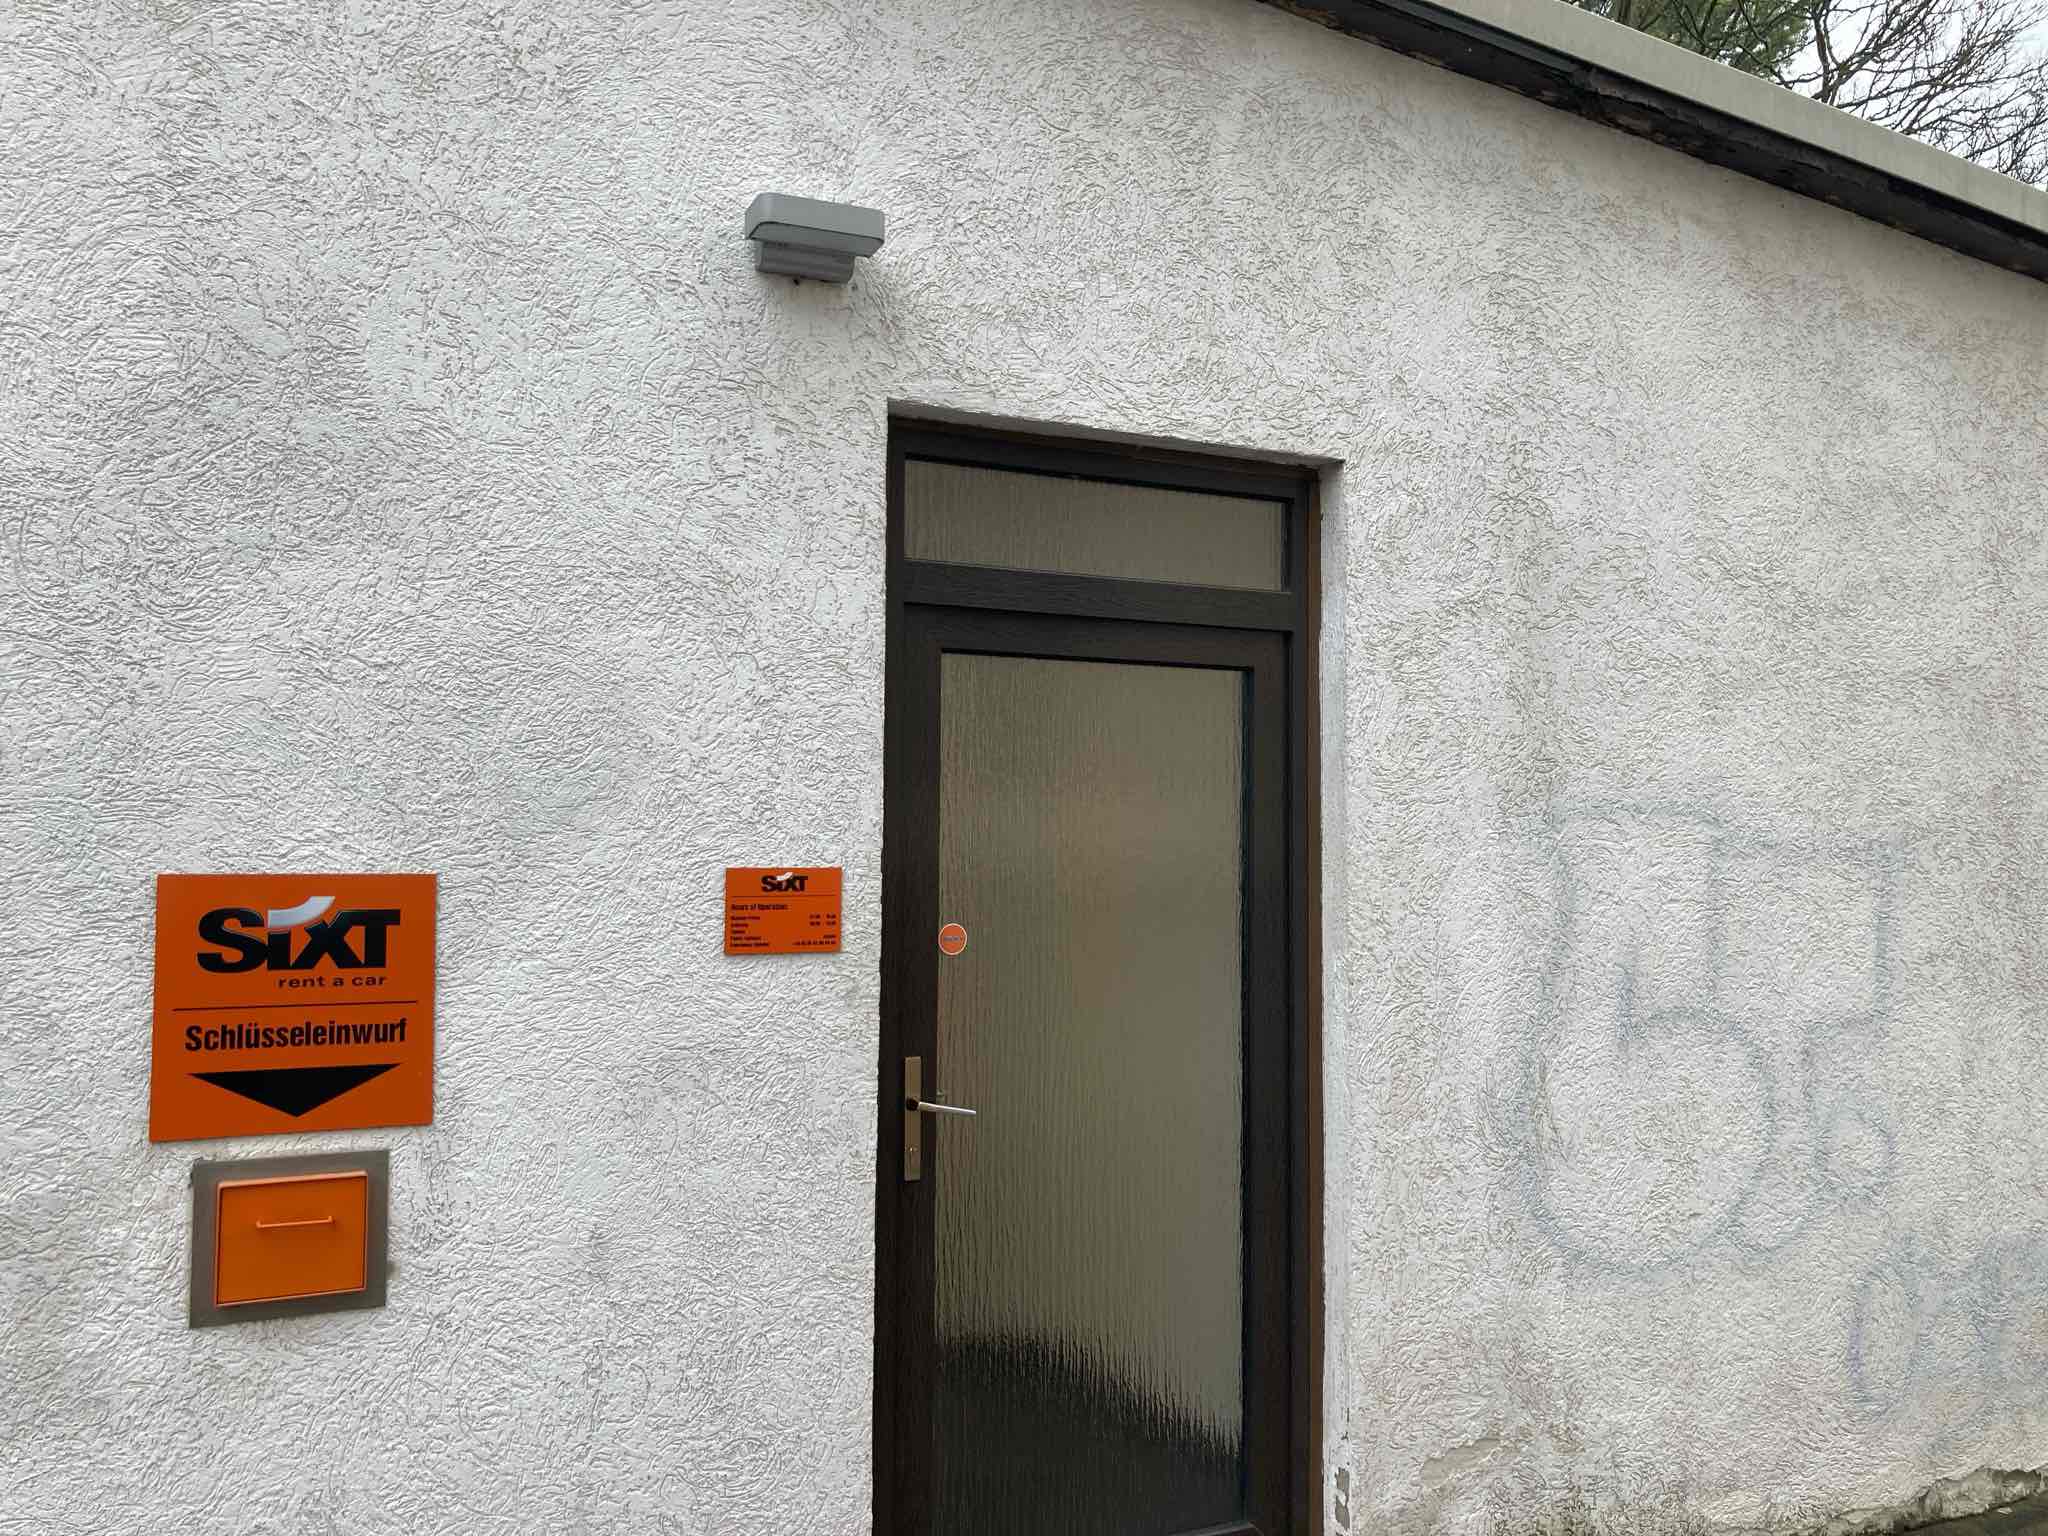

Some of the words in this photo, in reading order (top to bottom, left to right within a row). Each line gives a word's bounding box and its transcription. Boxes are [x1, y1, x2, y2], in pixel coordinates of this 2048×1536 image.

[278, 976, 325, 989] rent
[332, 977, 344, 987] a
[352, 975, 387, 987] car
[185, 1017, 407, 1051] Schlüsseleinwurf
